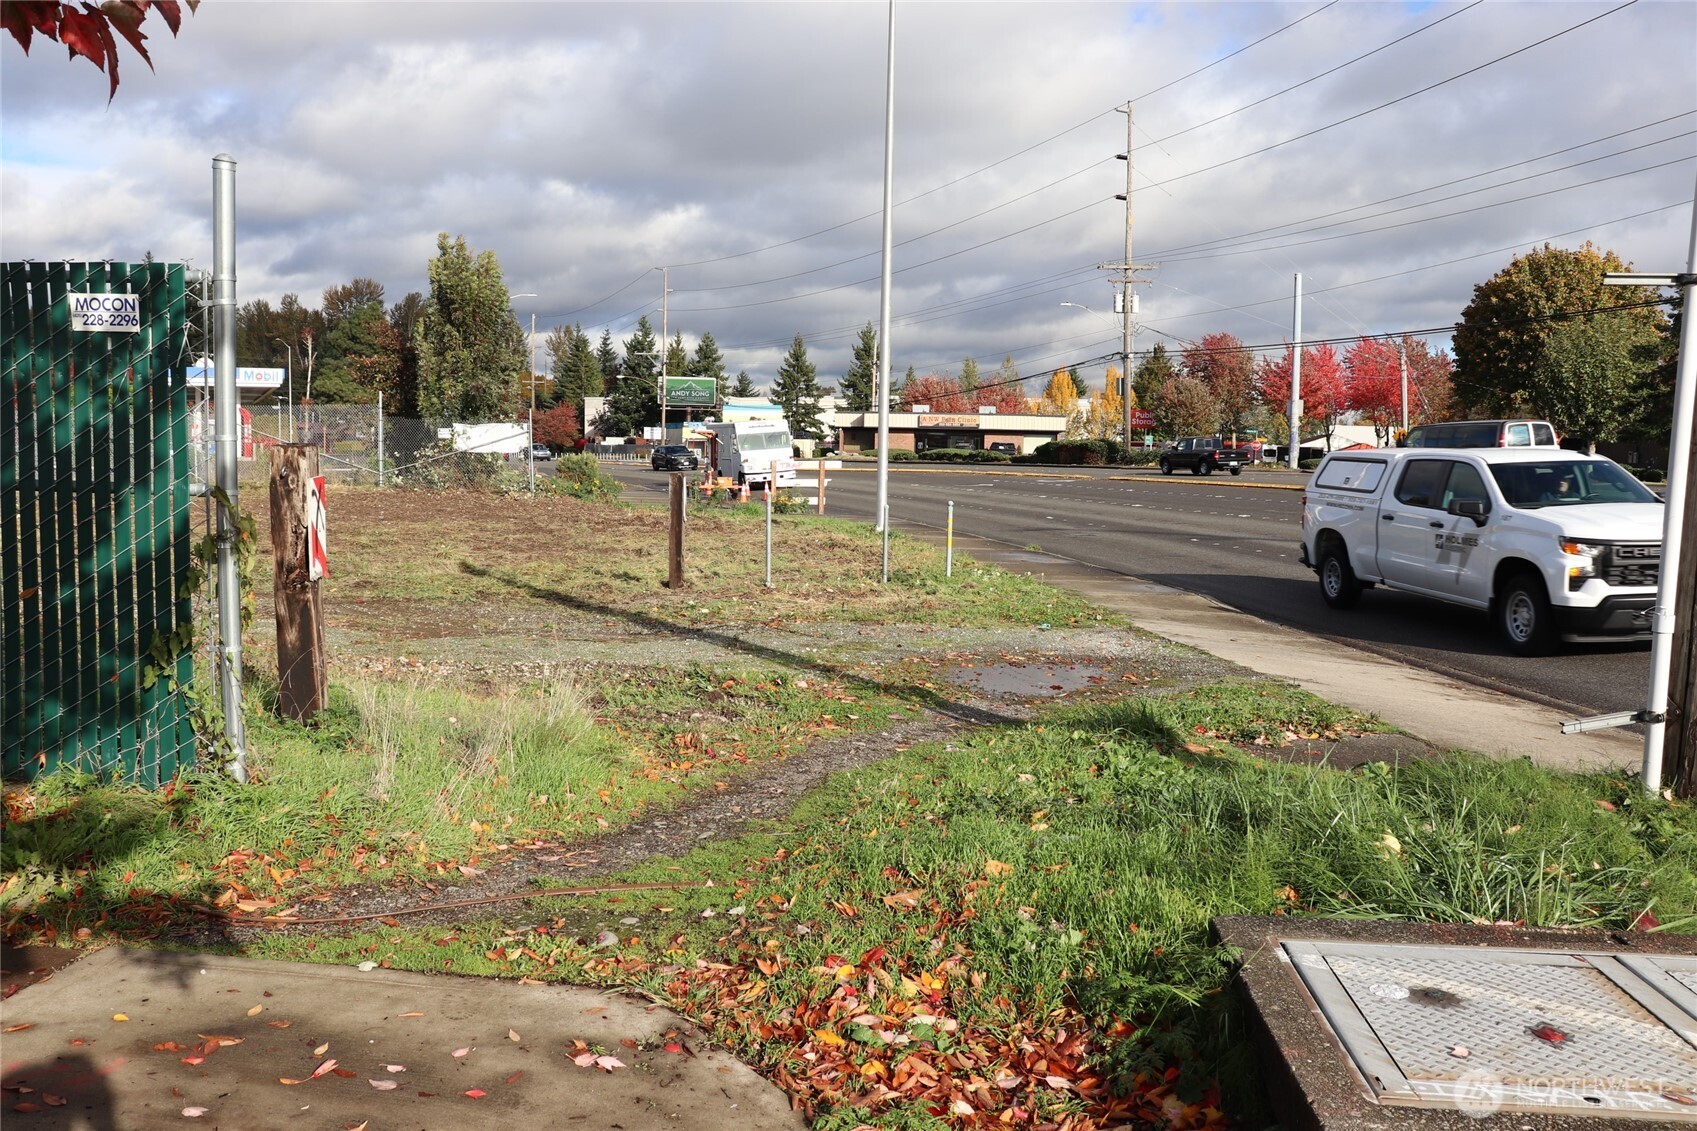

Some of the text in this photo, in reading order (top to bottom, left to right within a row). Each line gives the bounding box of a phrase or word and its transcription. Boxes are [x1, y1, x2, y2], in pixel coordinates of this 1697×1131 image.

[75, 297, 136, 312] MOCON
[82, 313, 138, 327] 228-2296
[243, 370, 279, 382] Mobil
[1131, 418, 1157, 426] Storag
[1445, 534, 1480, 547] HOLMES
